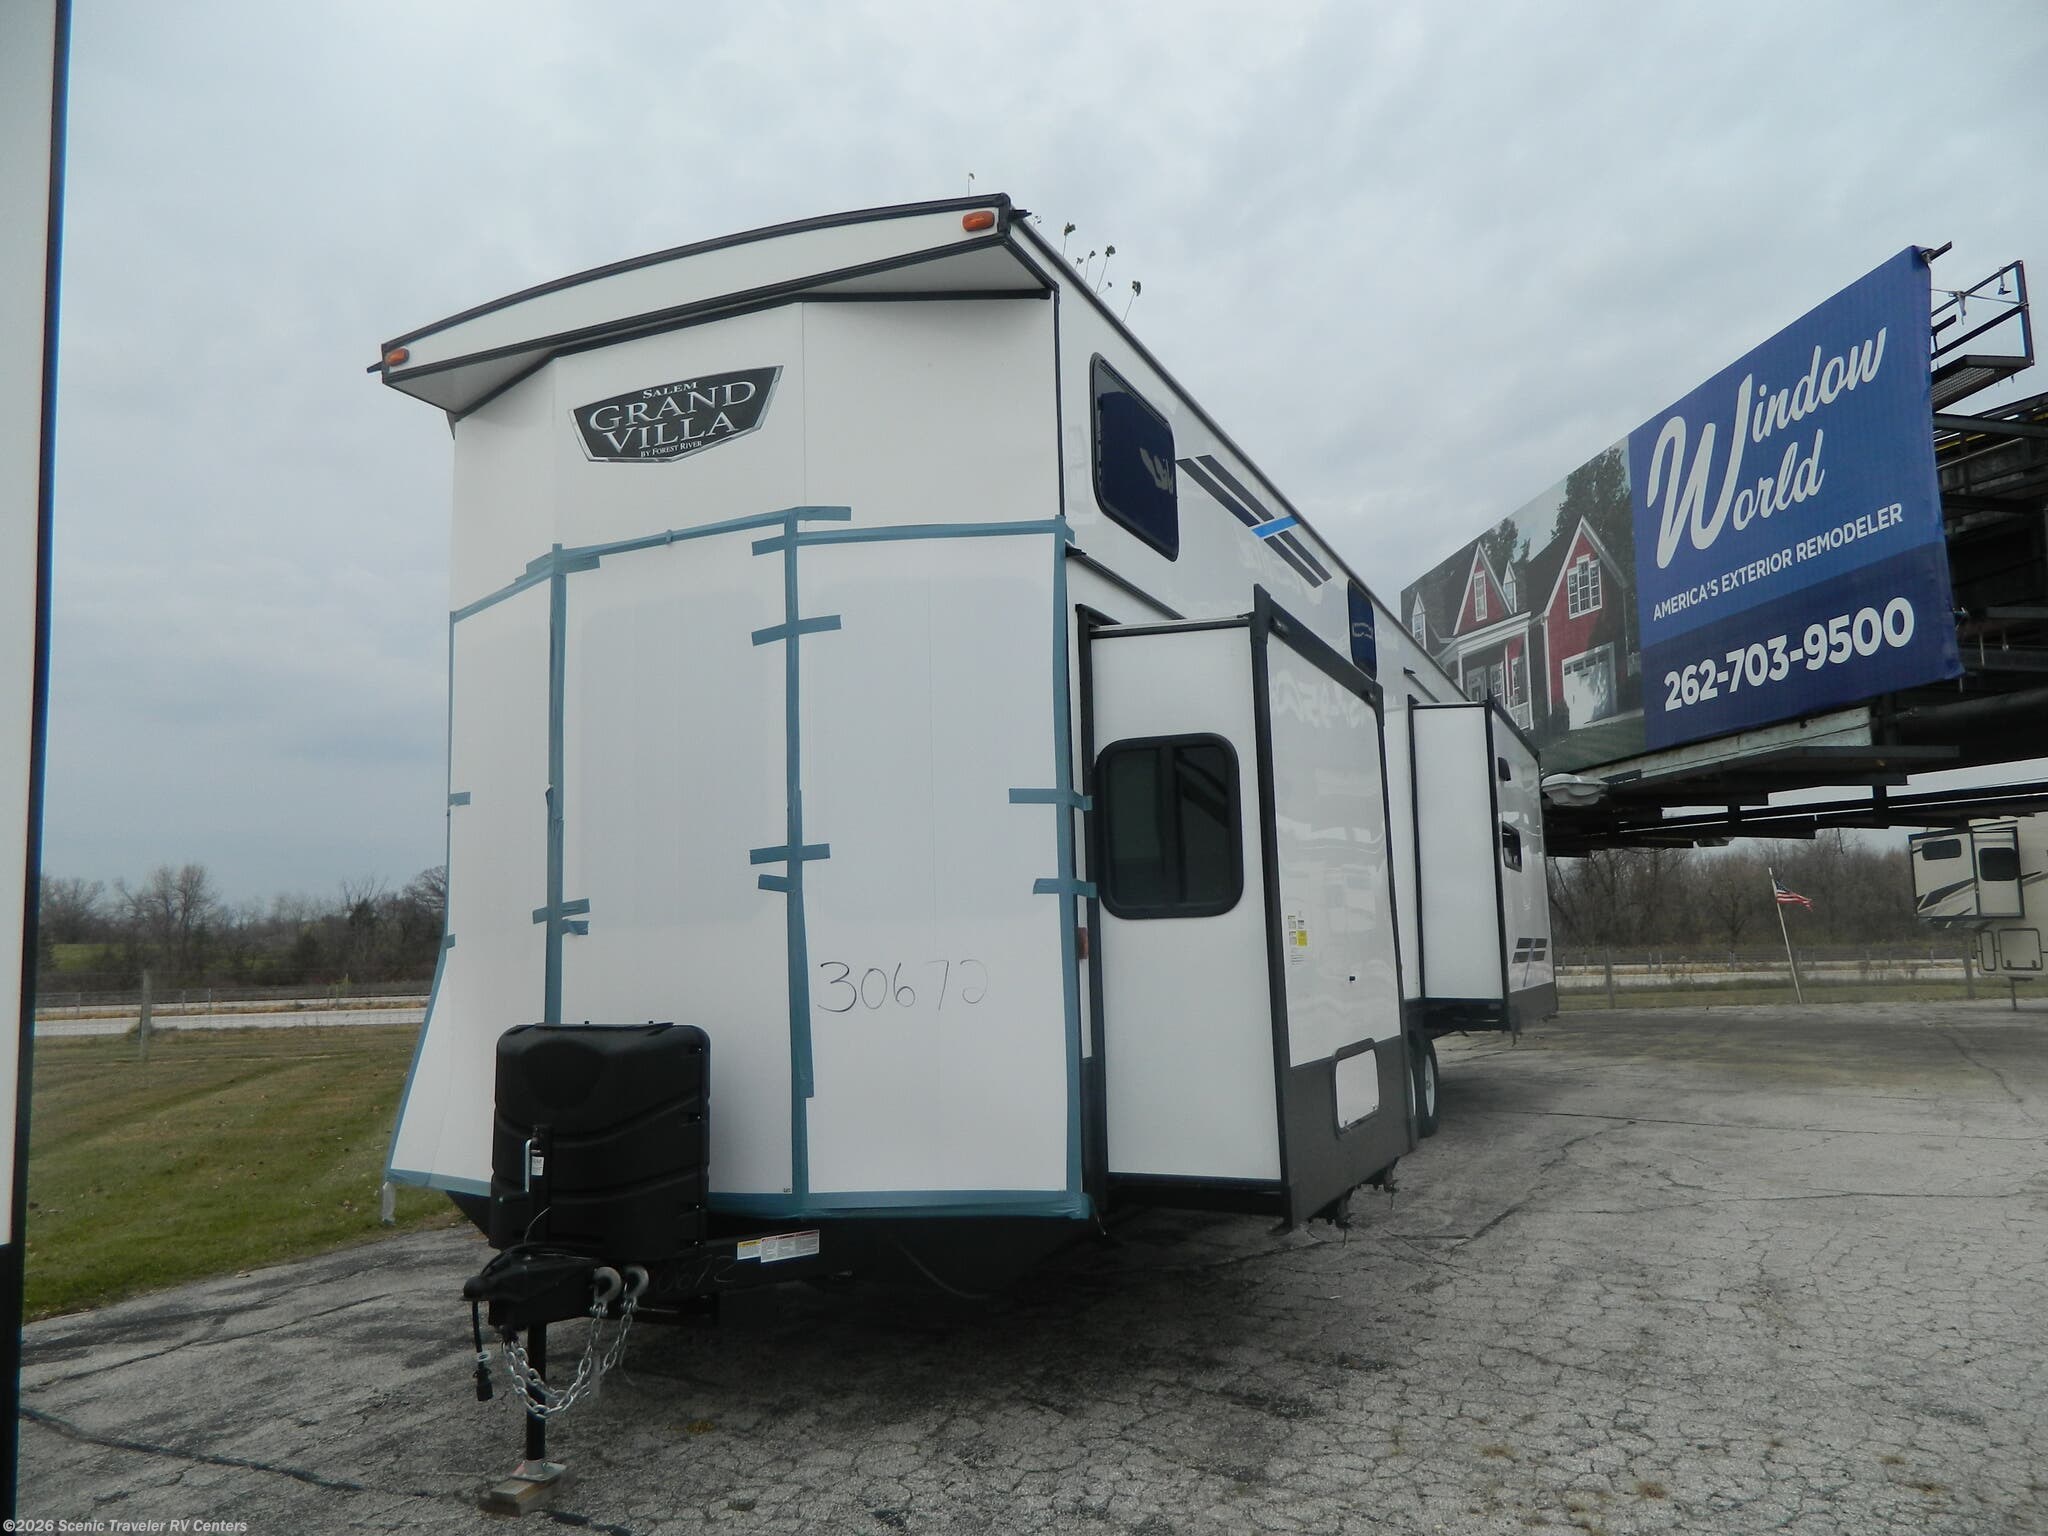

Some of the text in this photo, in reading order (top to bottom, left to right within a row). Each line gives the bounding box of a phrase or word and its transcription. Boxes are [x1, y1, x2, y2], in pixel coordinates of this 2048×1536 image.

[589, 381, 757, 432] GRAND
[642, 381, 697, 399] SALEM
[603, 411, 739, 454] VILLA
[640, 440, 703, 458] BY FOREST RIVER
[1646, 327, 1887, 570] Window
[1653, 501, 1904, 622] AMERICA'S EXTERIOR REMODELER
[1663, 596, 1916, 712] 262-703-9500
